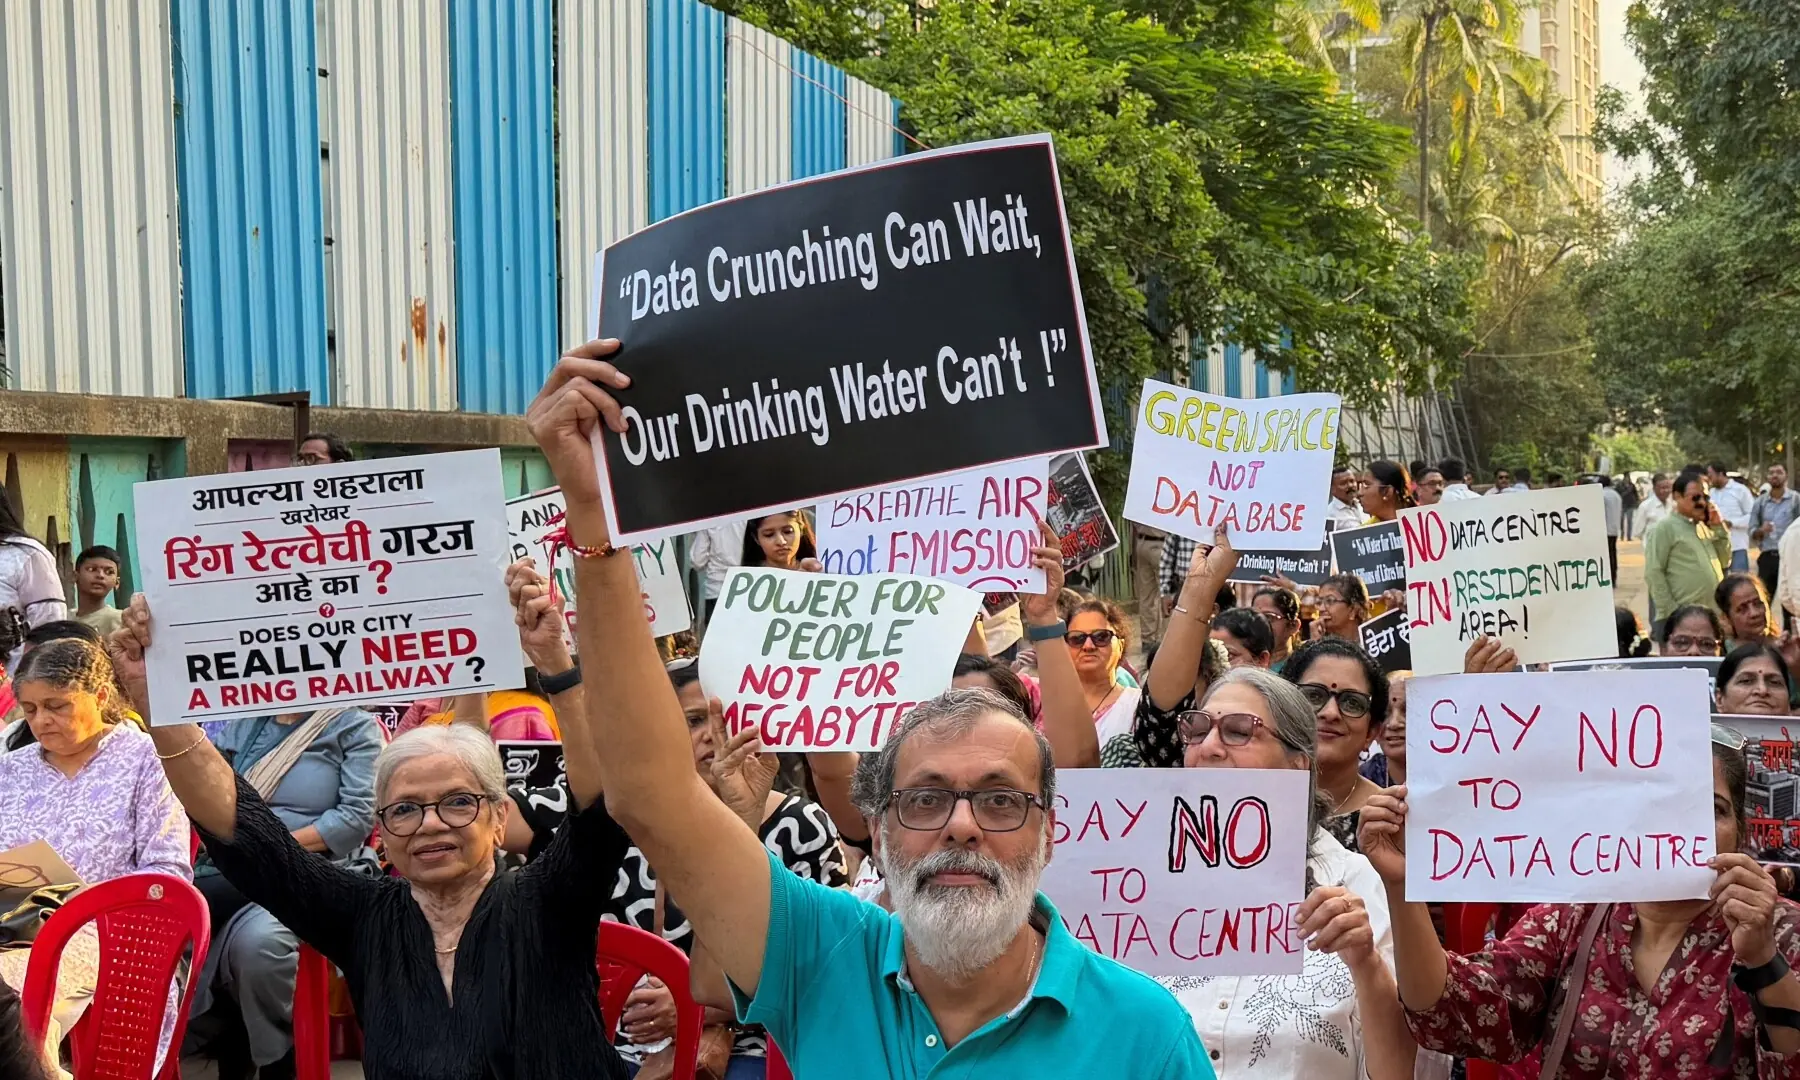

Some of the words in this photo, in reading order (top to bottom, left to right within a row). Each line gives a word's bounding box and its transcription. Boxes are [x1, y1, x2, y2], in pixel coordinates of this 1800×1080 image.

[618, 260, 700, 322] “Data
[706, 225, 880, 303] Crunching
[884, 211, 952, 270] Can
[953, 193, 1043, 258] Wait,
[618, 405, 682, 467] Our
[685, 376, 829, 455] Drinking
[829, 359, 929, 426] Water
[936, 336, 1028, 406] Can’t
[192, 478, 305, 512] आपल्या
[313, 468, 425, 500] शहराला
[1208, 460, 1265, 491] NOT
[279, 503, 351, 526] खरोखर
[830, 484, 967, 529] BREATHE
[977, 476, 1043, 525] AIR
[163, 534, 235, 580] रिंग
[241, 520, 372, 573] रेल्वेची
[379, 519, 475, 557] गरज
[820, 535, 879, 576] not
[1402, 510, 1447, 568] NO
[1450, 519, 1489, 550] DATA
[1491, 507, 1581, 544] CENTRE
[255, 572, 313, 604] आहे
[319, 574, 361, 597] का
[367, 559, 393, 596] ?
[1243, 554, 1275, 574] Drinking
[1275, 556, 1297, 572] Water
[725, 572, 861, 618] POWER
[870, 579, 946, 616] FOR
[1408, 577, 1452, 628] IN
[1452, 557, 1610, 609] RESIDENTIAL
[239, 625, 301, 646] DOES
[308, 619, 356, 638] OUR
[363, 613, 413, 633] CITY
[761, 617, 915, 661] PEOPLE
[1365, 629, 1395, 658] डेटा
[186, 640, 347, 683] REALLY
[361, 627, 477, 666] NEED
[188, 688, 212, 711] A
[220, 679, 297, 708] RING
[308, 662, 455, 699] RAILWAY
[465, 656, 485, 683] ?
[738, 664, 822, 701] NOT
[834, 661, 900, 700] FOR
[1429, 699, 1541, 755] SAY
[1577, 704, 1663, 772] NO
[1458, 777, 1522, 811] TO
[1055, 795, 1148, 844] SAY
[1168, 794, 1272, 874] NO
[1428, 828, 1555, 882] DATA
[1569, 832, 1710, 877] CENTRE
[1091, 867, 1147, 903] TO
[1066, 912, 1158, 961] ATA
[1169, 902, 1302, 961] CENTRE
